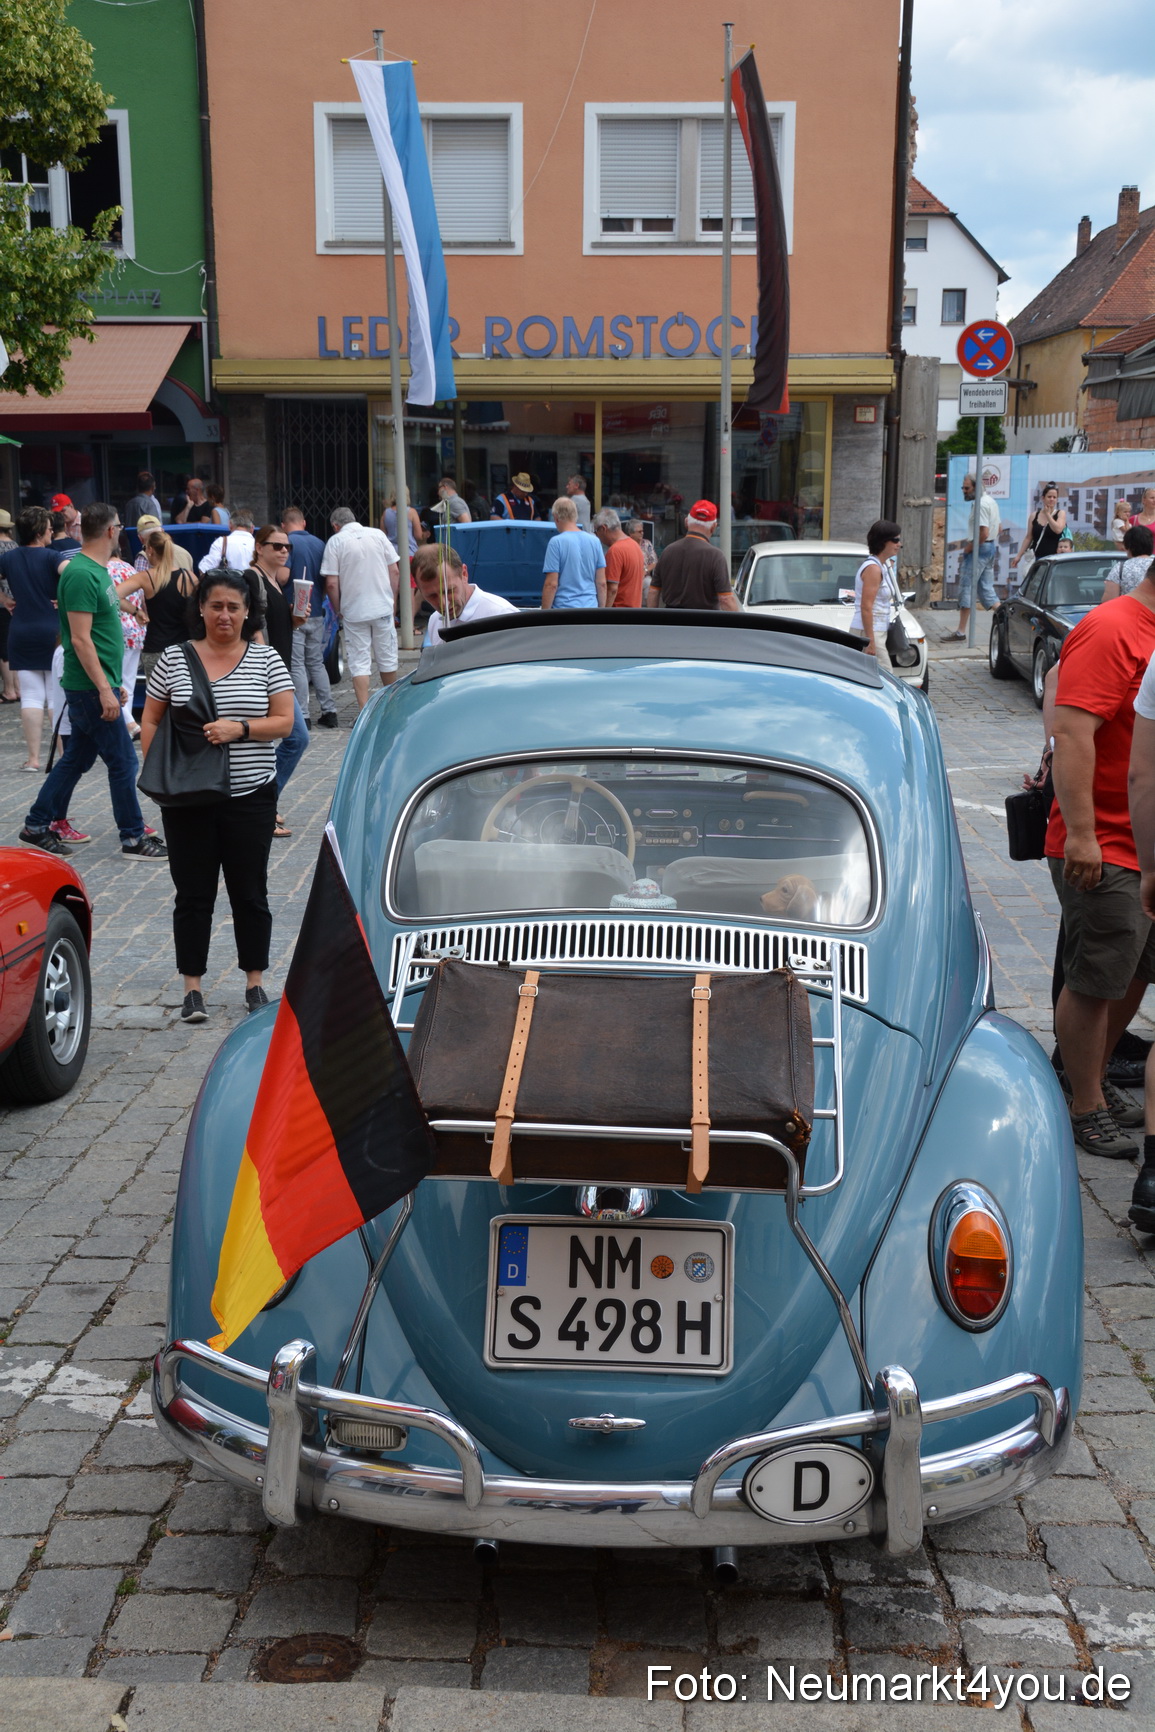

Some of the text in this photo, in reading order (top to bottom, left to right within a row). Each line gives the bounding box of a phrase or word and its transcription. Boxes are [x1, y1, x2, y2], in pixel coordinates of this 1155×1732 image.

[317, 312, 759, 359] LEDR ROMSTÖC
[963, 388, 1004, 397] Wendebereich
[969, 400, 997, 408] freihalten
[507, 1263, 519, 1279] D
[569, 1235, 642, 1290] NM
[507, 1295, 712, 1356] S 498 H
[793, 1460, 830, 1512] D
